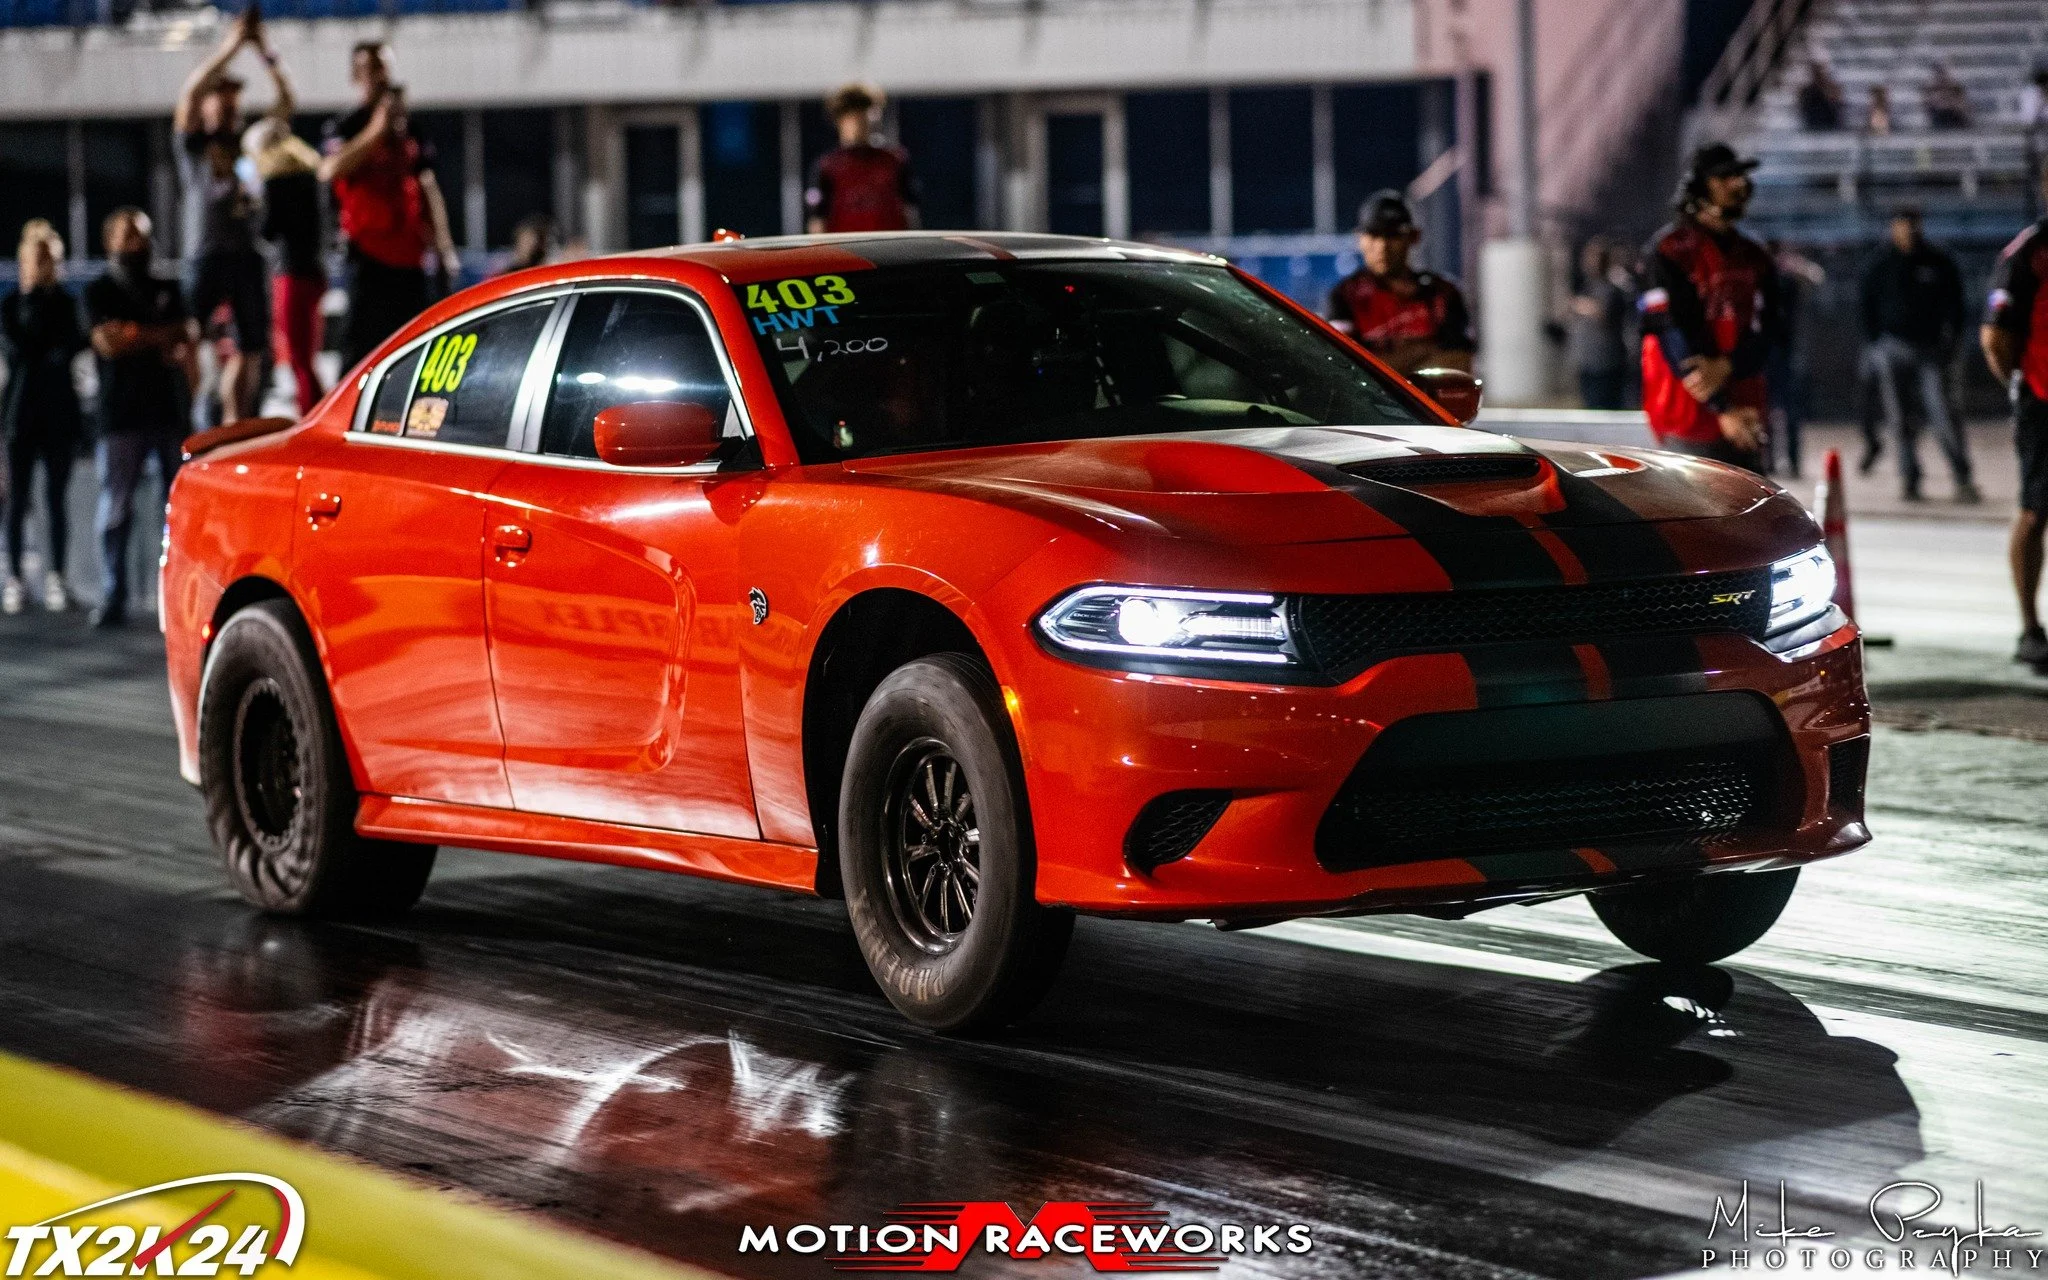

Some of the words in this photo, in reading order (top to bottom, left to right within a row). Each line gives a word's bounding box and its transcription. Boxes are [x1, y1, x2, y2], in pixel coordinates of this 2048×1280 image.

[746, 275, 856, 313] 403
[752, 305, 839, 335] HWT
[420, 333, 478, 392] 403
[776, 336, 889, 362] 4,200
[1708, 589, 1756, 605] SRT
